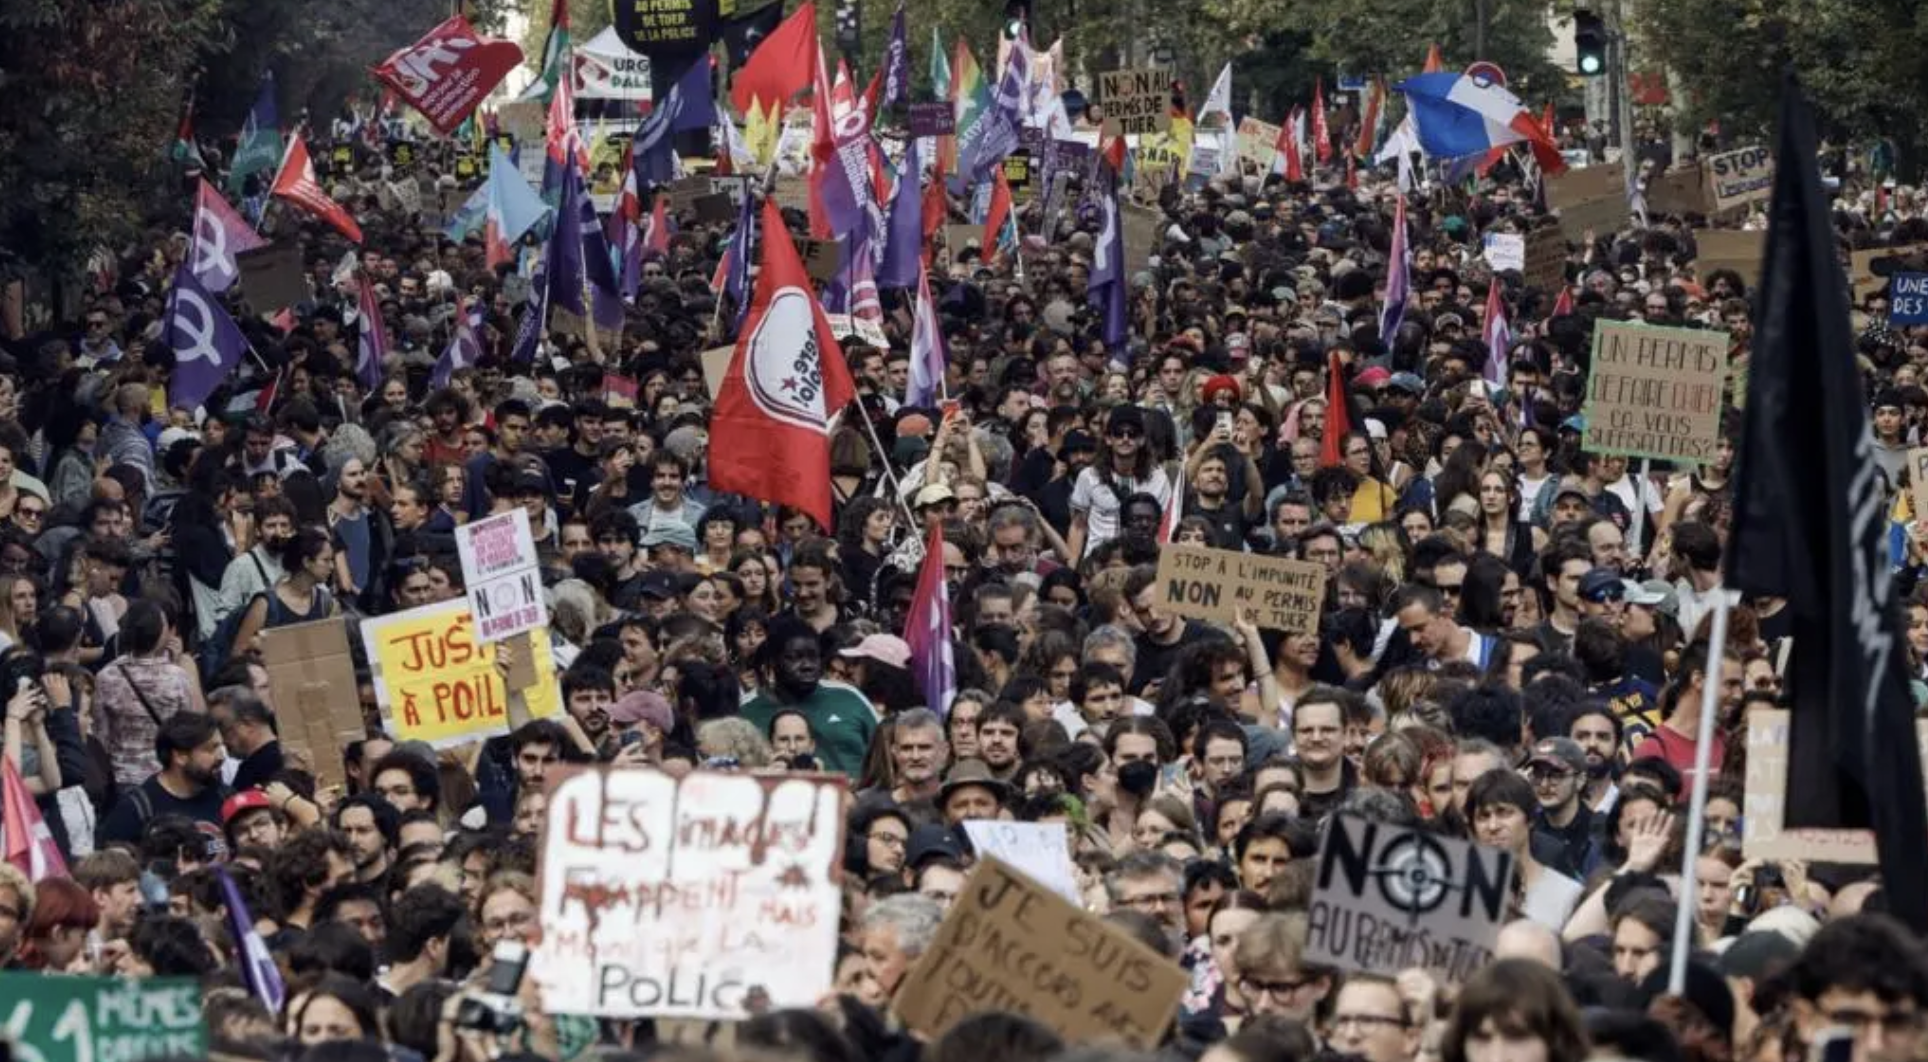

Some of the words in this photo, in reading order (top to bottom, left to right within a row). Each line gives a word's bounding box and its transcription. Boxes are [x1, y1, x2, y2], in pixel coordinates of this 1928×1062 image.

[659, 12, 686, 25] TUER
[661, 27, 696, 39] POLICE
[1104, 72, 1149, 97] NON
[1152, 71, 1170, 92] AU
[1104, 97, 1141, 117] PERMIS
[1144, 95, 1162, 113] DE
[1119, 116, 1157, 133] TUER
[1714, 148, 1769, 176] STOP
[1896, 277, 1928, 295] UNE
[1893, 297, 1922, 315] DES
[1598, 333, 1628, 362] UN
[1637, 337, 1717, 373] PERMIS
[1618, 375, 1669, 409] FAIRE
[1644, 412, 1692, 435] VOUS
[1173, 553, 1211, 569] STOP
[1218, 556, 1226, 574] À
[1239, 562, 1318, 591] L'IMPUNITÉ
[1167, 579, 1222, 607] NON
[1235, 586, 1254, 600] AU
[1264, 590, 1316, 611] PERMIS
[1245, 609, 1260, 622] DE
[1272, 612, 1309, 628] TUER
[400, 689, 421, 725] À
[567, 796, 650, 852] LES
[1318, 814, 1511, 922] NON
[759, 902, 816, 927] MAIS
[1306, 901, 1352, 956] AU
[977, 868, 1045, 933] JE
[1065, 917, 1150, 992] SUIS
[599, 964, 768, 1012] POLIC
